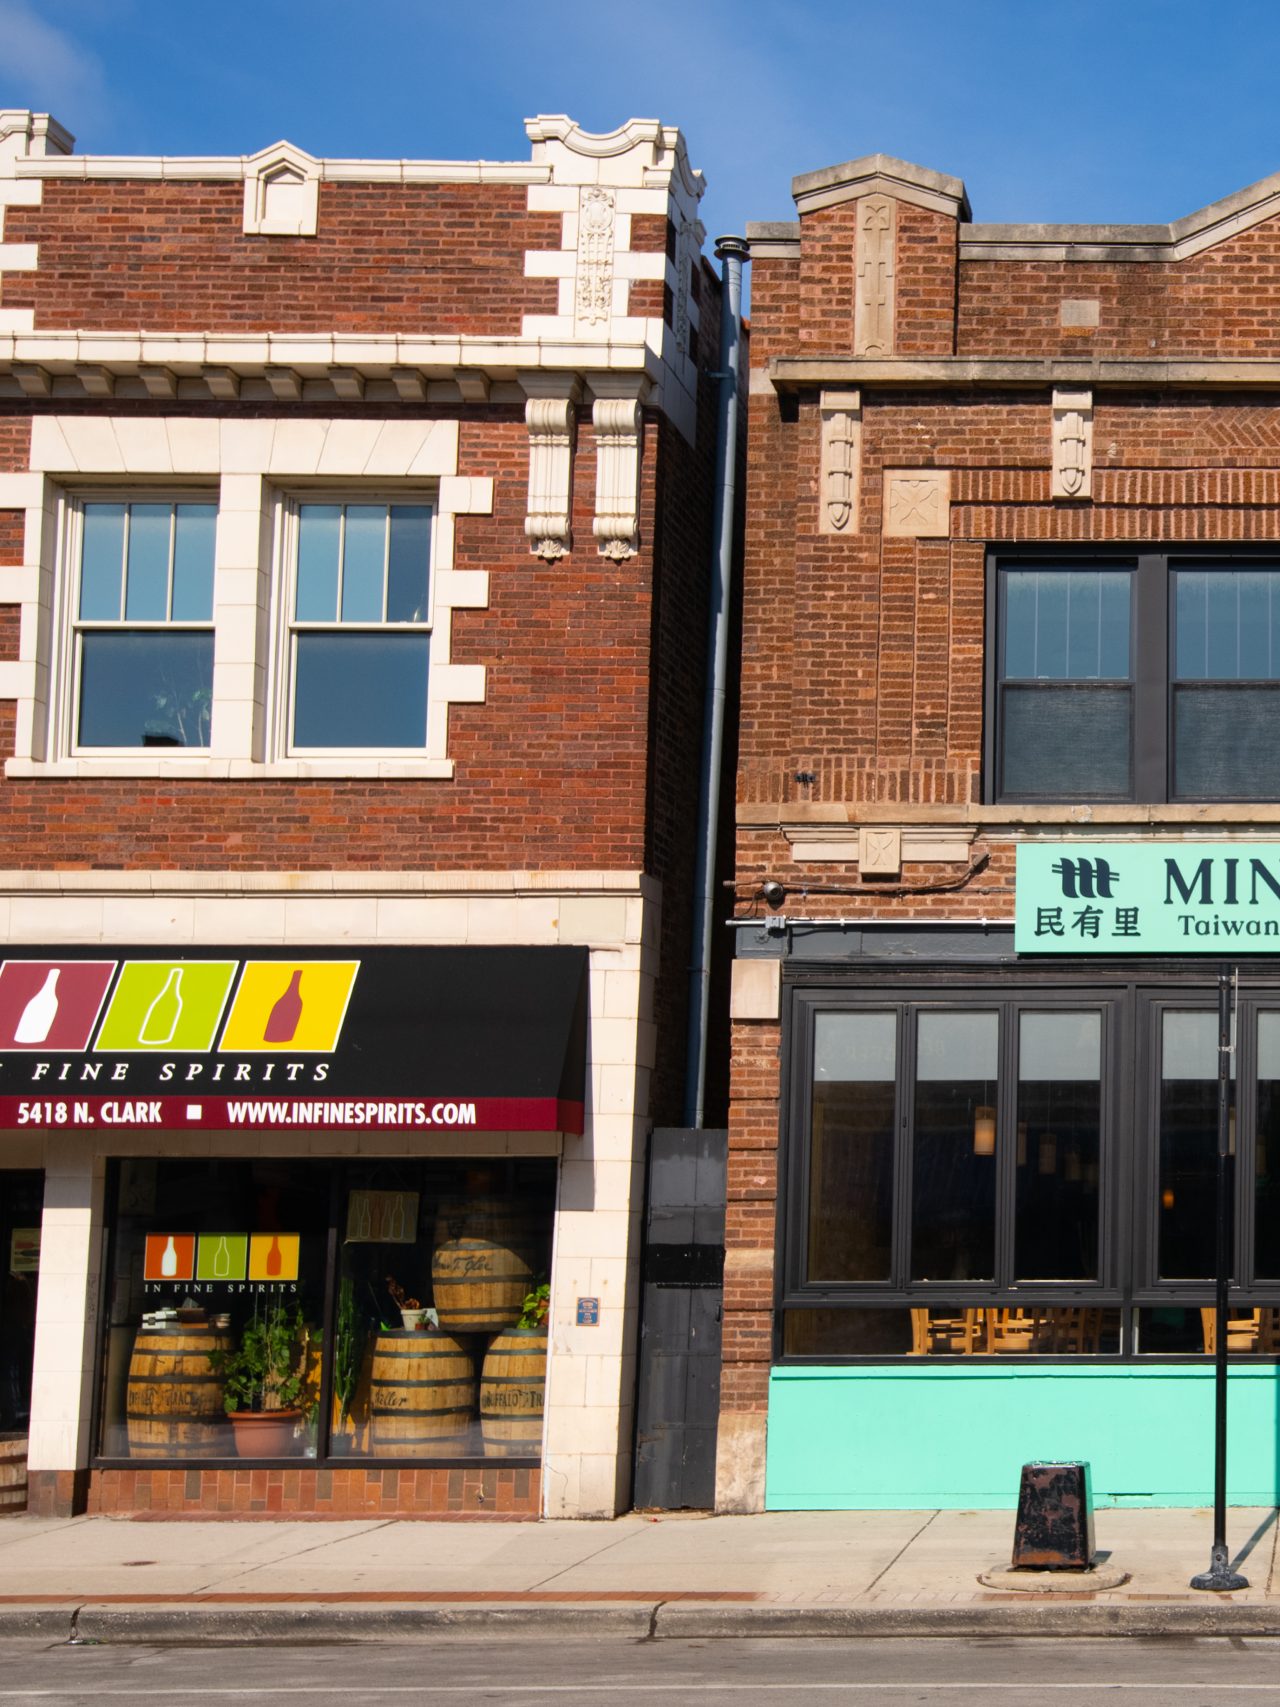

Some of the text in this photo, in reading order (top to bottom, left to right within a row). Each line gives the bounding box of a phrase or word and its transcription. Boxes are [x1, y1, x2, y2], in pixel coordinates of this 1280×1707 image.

[1033, 905, 1142, 939] 民有里
[31, 1063, 329, 1081] FINE SPIRITS
[17, 1102, 476, 1124] 5418 N. CLARK WWW.INFINESPIRITS.COM
[144, 1284, 297, 1293] IN FINE SPIRITS
